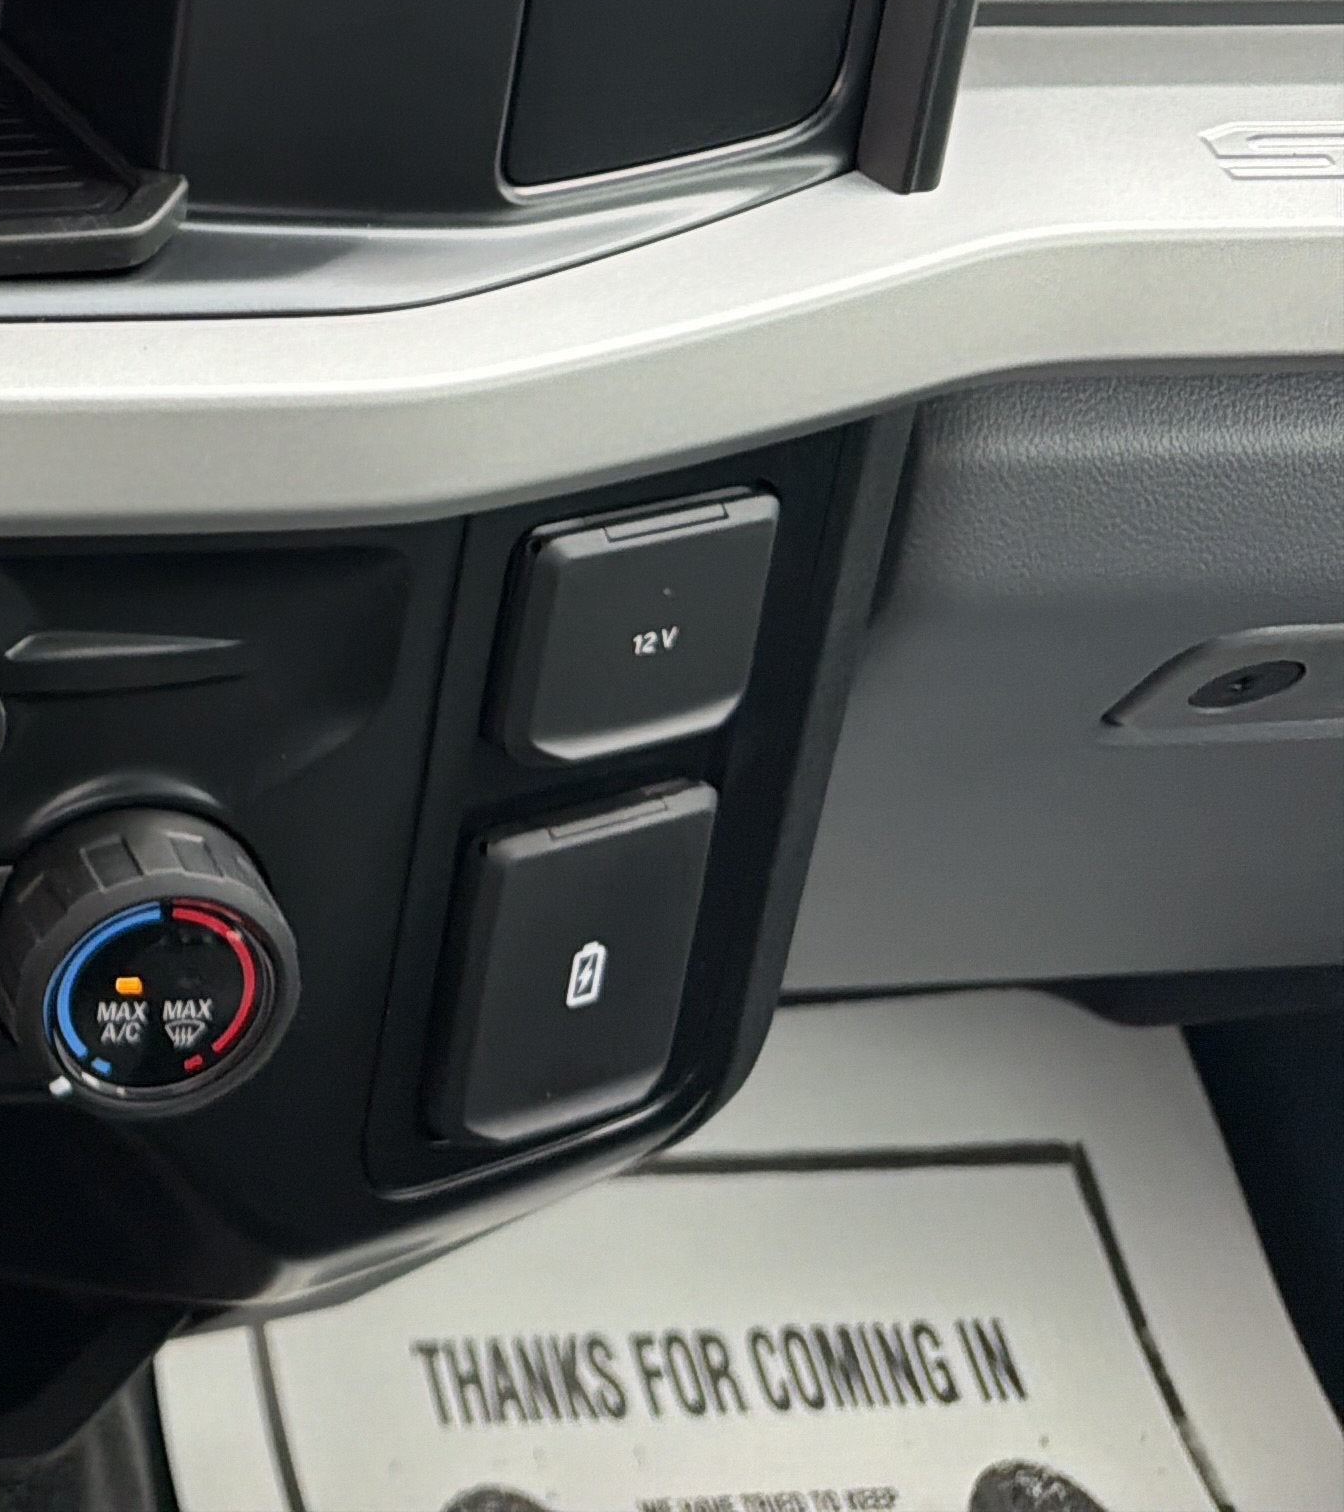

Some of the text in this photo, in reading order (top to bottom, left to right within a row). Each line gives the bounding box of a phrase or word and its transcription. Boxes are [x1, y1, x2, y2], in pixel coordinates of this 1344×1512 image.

[633, 626, 679, 656] 12 V
[97, 1001, 148, 1023] MAX
[163, 998, 213, 1021] MAX
[100, 1022, 141, 1042] A/C
[411, 1315, 1029, 1429] THANKS FOR COMING IN
